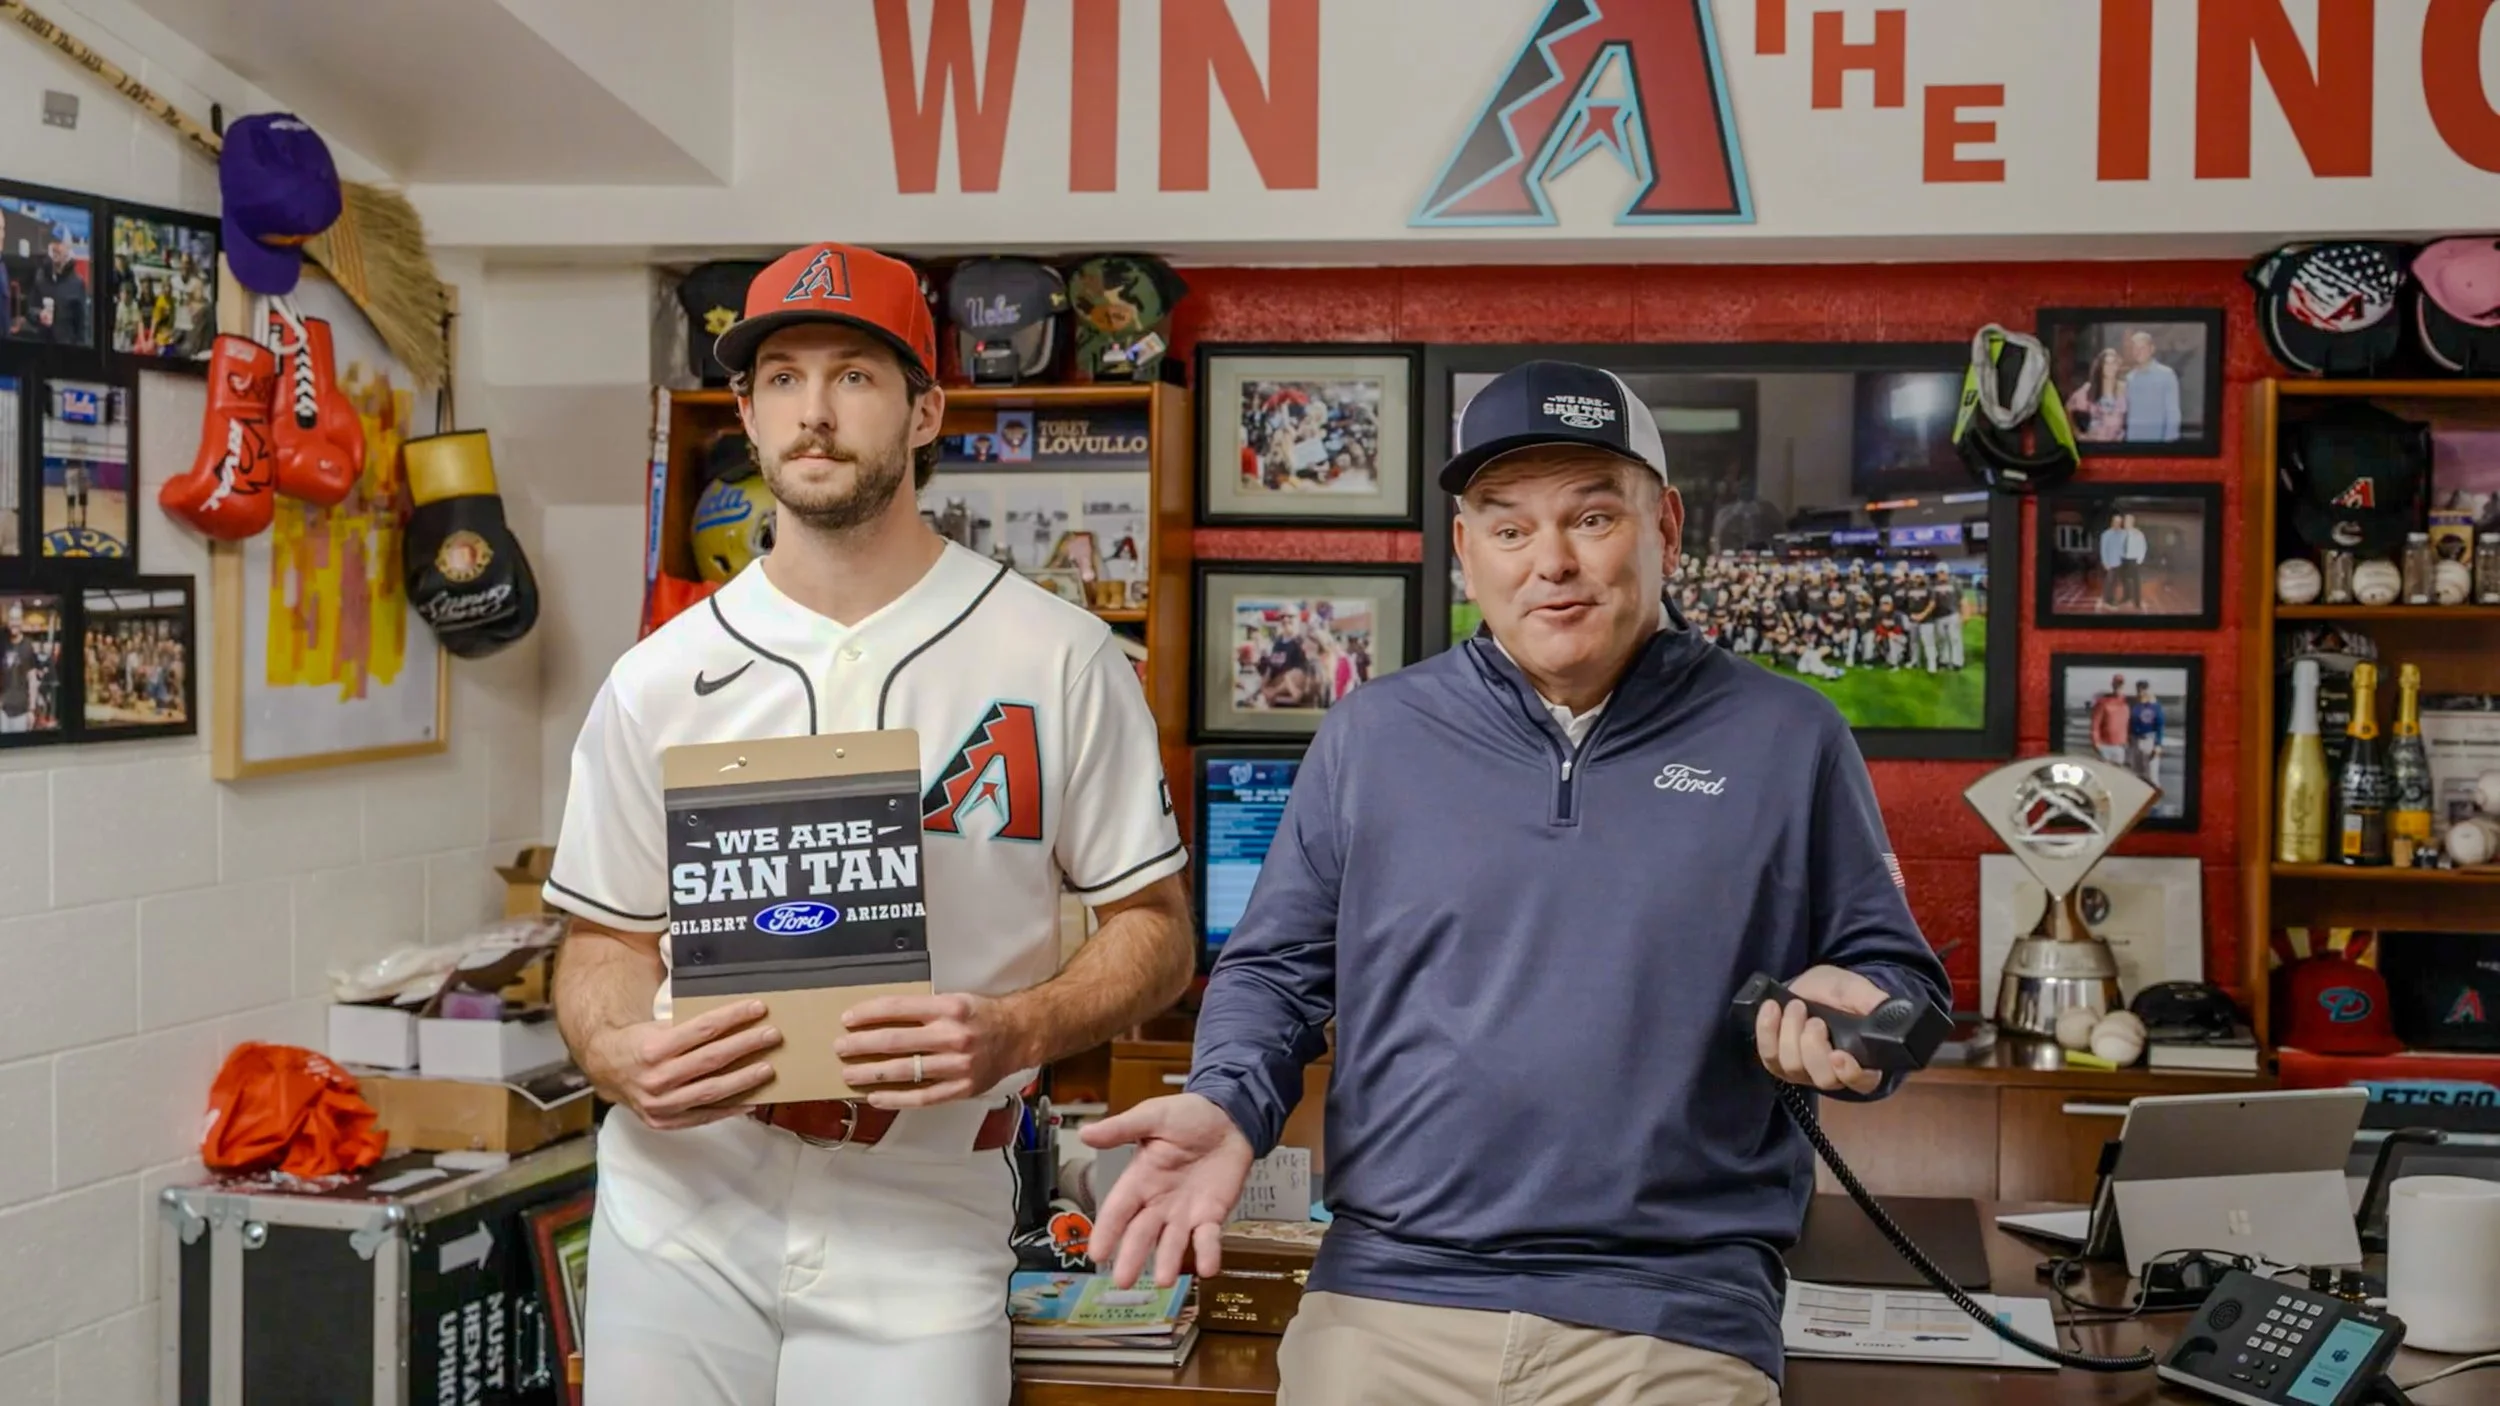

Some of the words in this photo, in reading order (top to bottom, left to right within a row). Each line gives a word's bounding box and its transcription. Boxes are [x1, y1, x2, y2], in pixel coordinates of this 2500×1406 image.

[873, 0, 1320, 194] WIN
[1037, 420, 1089, 437] TOREY
[1542, 402, 1580, 415] SAN
[1581, 405, 1616, 421] TAN
[1037, 435, 1148, 455] LOVULLO
[1654, 763, 1727, 796] Ford
[715, 827, 780, 855] WE
[788, 819, 873, 850] ARE
[672, 855, 789, 905] SAN
[801, 845, 919, 896] TAN
[670, 915, 748, 937] GILBERT
[766, 903, 827, 933] Ford
[846, 902, 927, 923] ARIZONA
[486, 1291, 505, 1389] MUST
